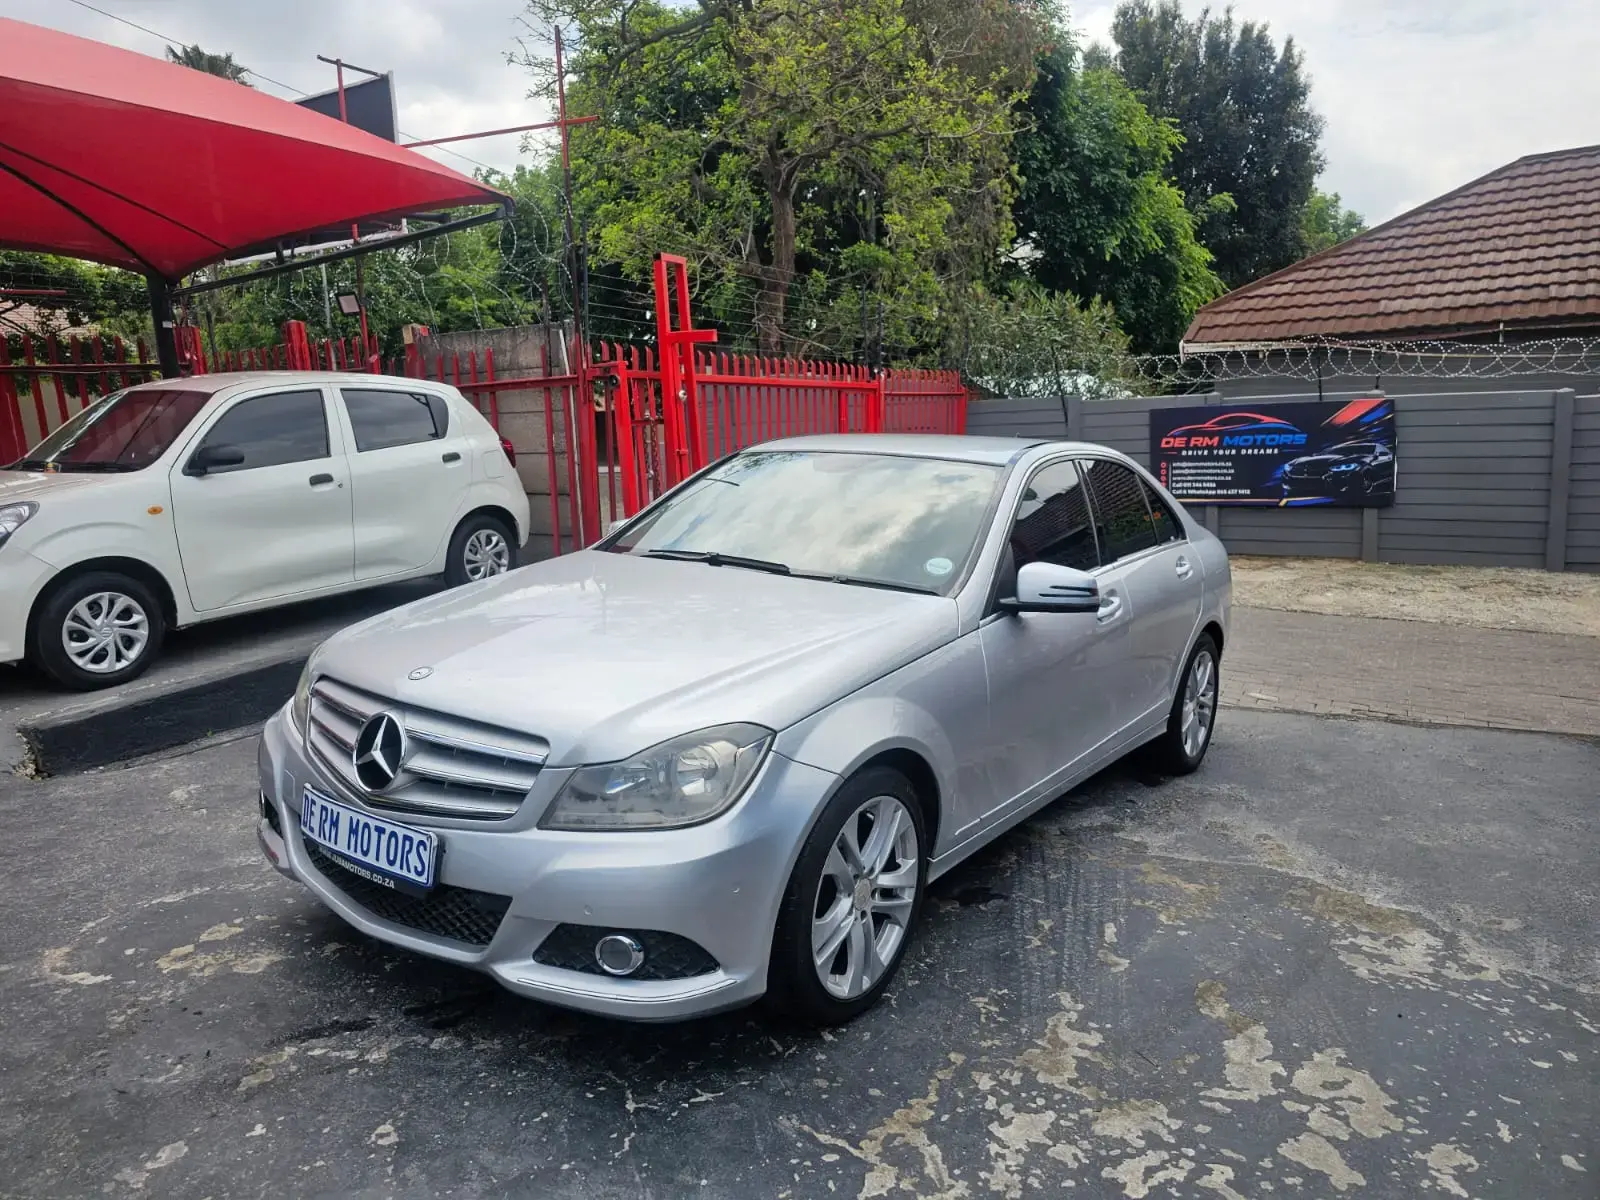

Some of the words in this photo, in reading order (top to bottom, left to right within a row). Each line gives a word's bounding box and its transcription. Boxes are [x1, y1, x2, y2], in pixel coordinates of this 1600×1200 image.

[1160, 436, 1188, 448] DE
[1189, 436, 1219, 447] RM
[1223, 434, 1308, 446] MOTORS
[302, 793, 317, 833] DE
[318, 804, 340, 846] RM
[347, 815, 428, 877] MOTORS
